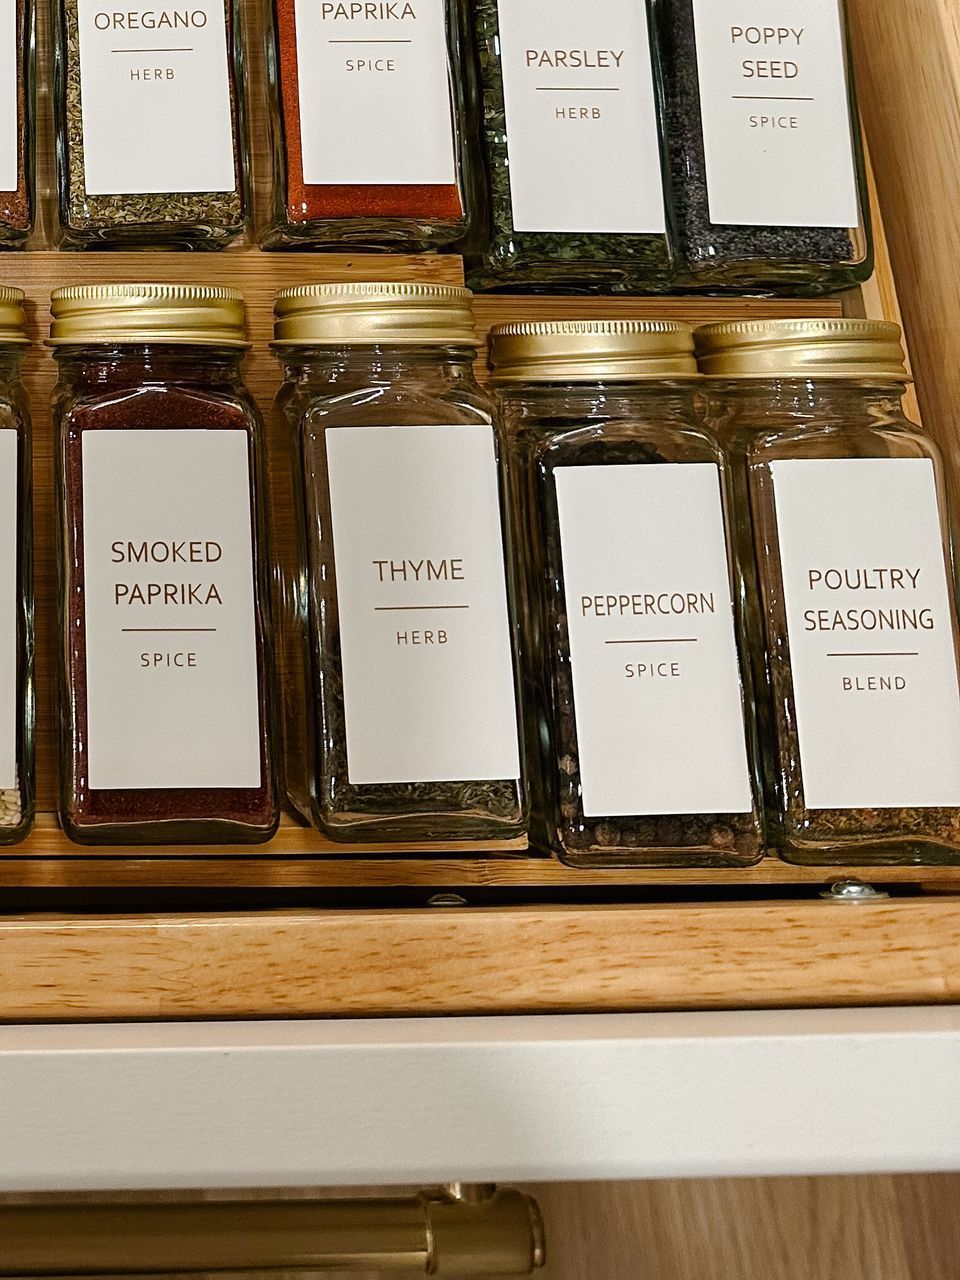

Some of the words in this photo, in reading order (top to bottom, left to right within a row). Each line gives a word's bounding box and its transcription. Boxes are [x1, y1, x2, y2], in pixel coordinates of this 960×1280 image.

[94, 9, 208, 31] OREGANO
[321, 1, 417, 21] PAPRIKA
[730, 26, 805, 46] POPPY
[344, 58, 396, 72] SPICE
[525, 49, 625, 68] PARSLEY
[130, 68, 175, 81] HERB
[741, 59, 799, 79] SEED
[555, 106, 601, 120] HERB
[748, 115, 799, 129] SPICE
[110, 540, 223, 564] SMOKED
[371, 558, 465, 583] THYME
[808, 567, 921, 591] POULTRY
[114, 583, 223, 606] PAPRIKA
[580, 592, 715, 618] PEPPERCORN
[801, 608, 935, 632] SEASONING
[396, 628, 448, 646] HERB
[140, 652, 198, 668] SPICE
[624, 662, 681, 678] SPICE
[842, 675, 906, 692] BLEND
